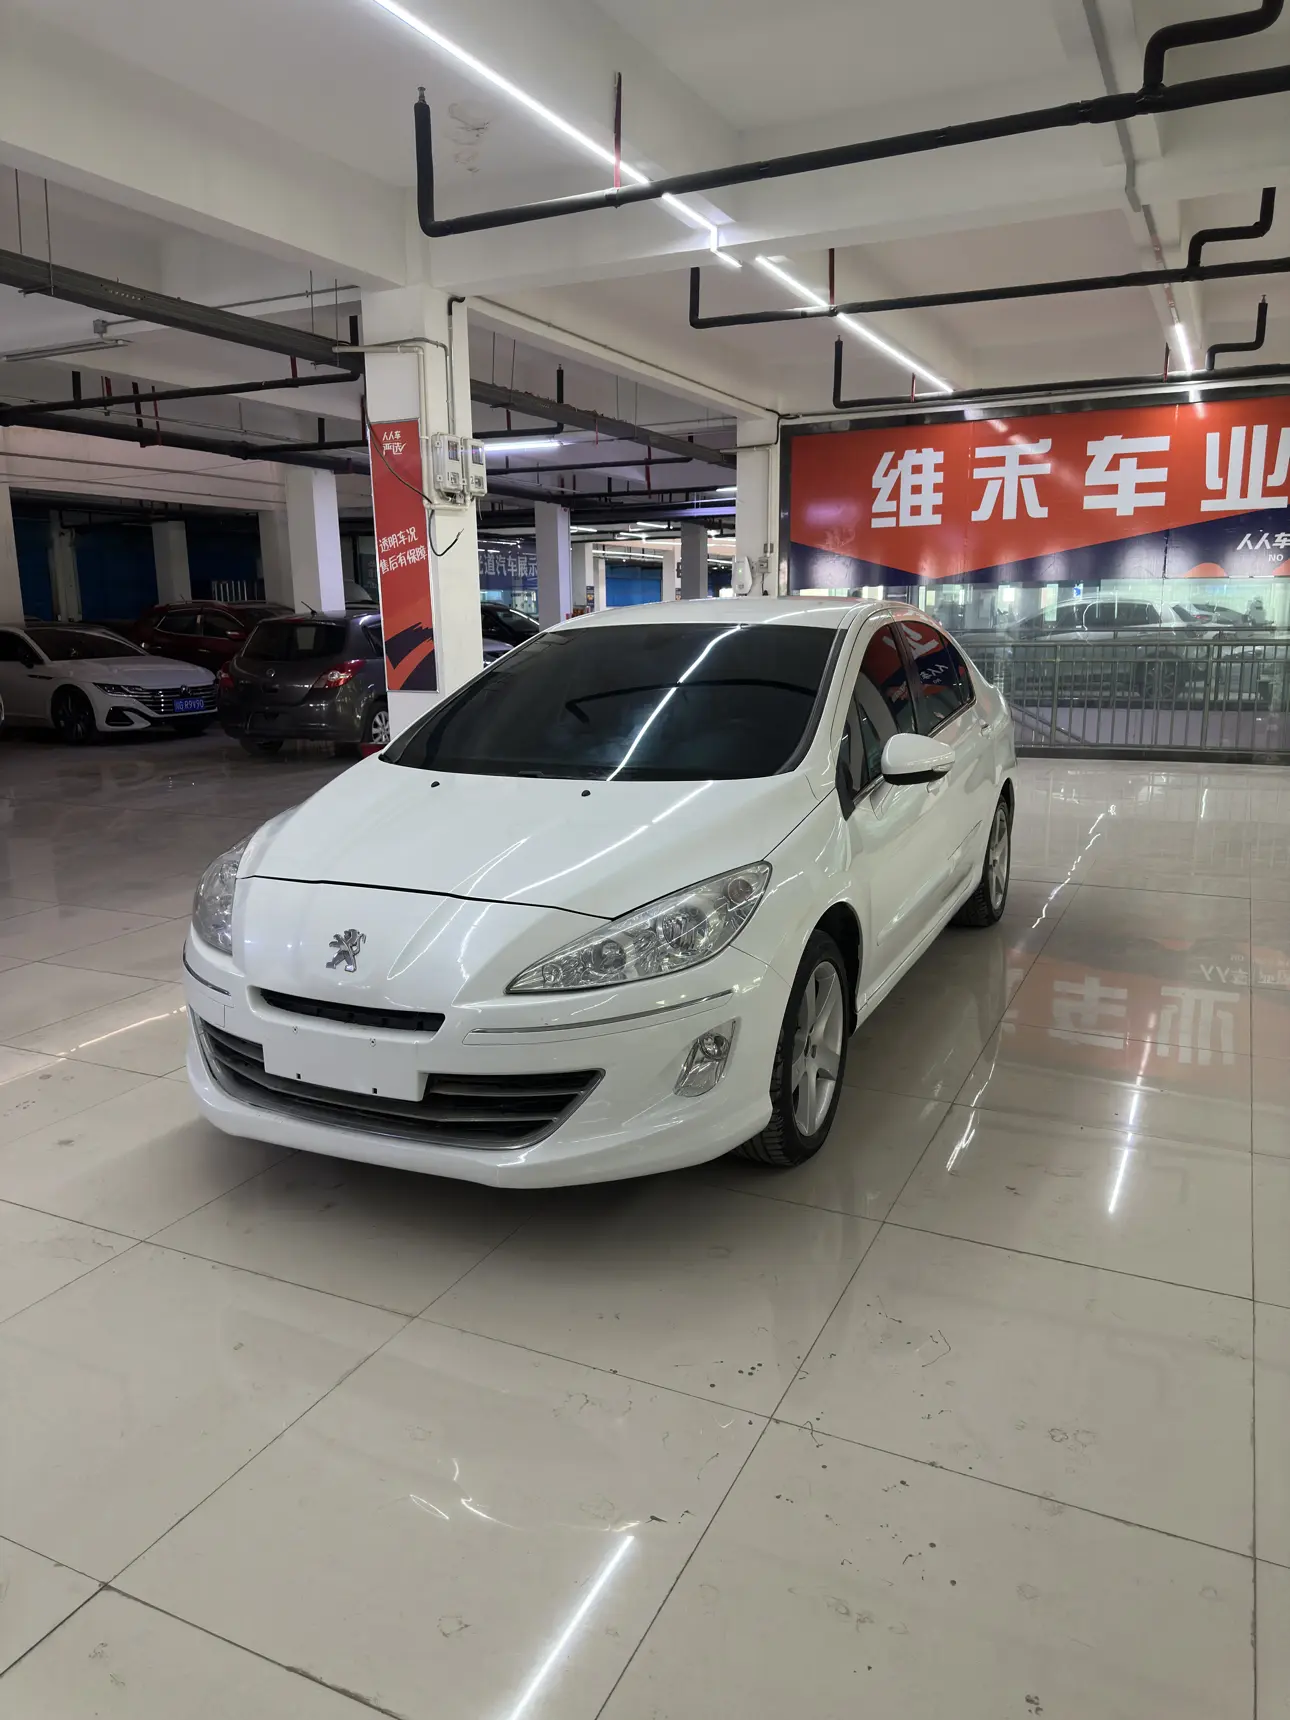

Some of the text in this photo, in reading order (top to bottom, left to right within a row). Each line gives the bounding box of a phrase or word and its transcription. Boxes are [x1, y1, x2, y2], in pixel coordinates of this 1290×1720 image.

[382, 430, 401, 441] 人人车
[871, 424, 1290, 528] 维禾车业
[379, 526, 418, 553] 透明车况
[379, 545, 428, 574] 售后有保障
